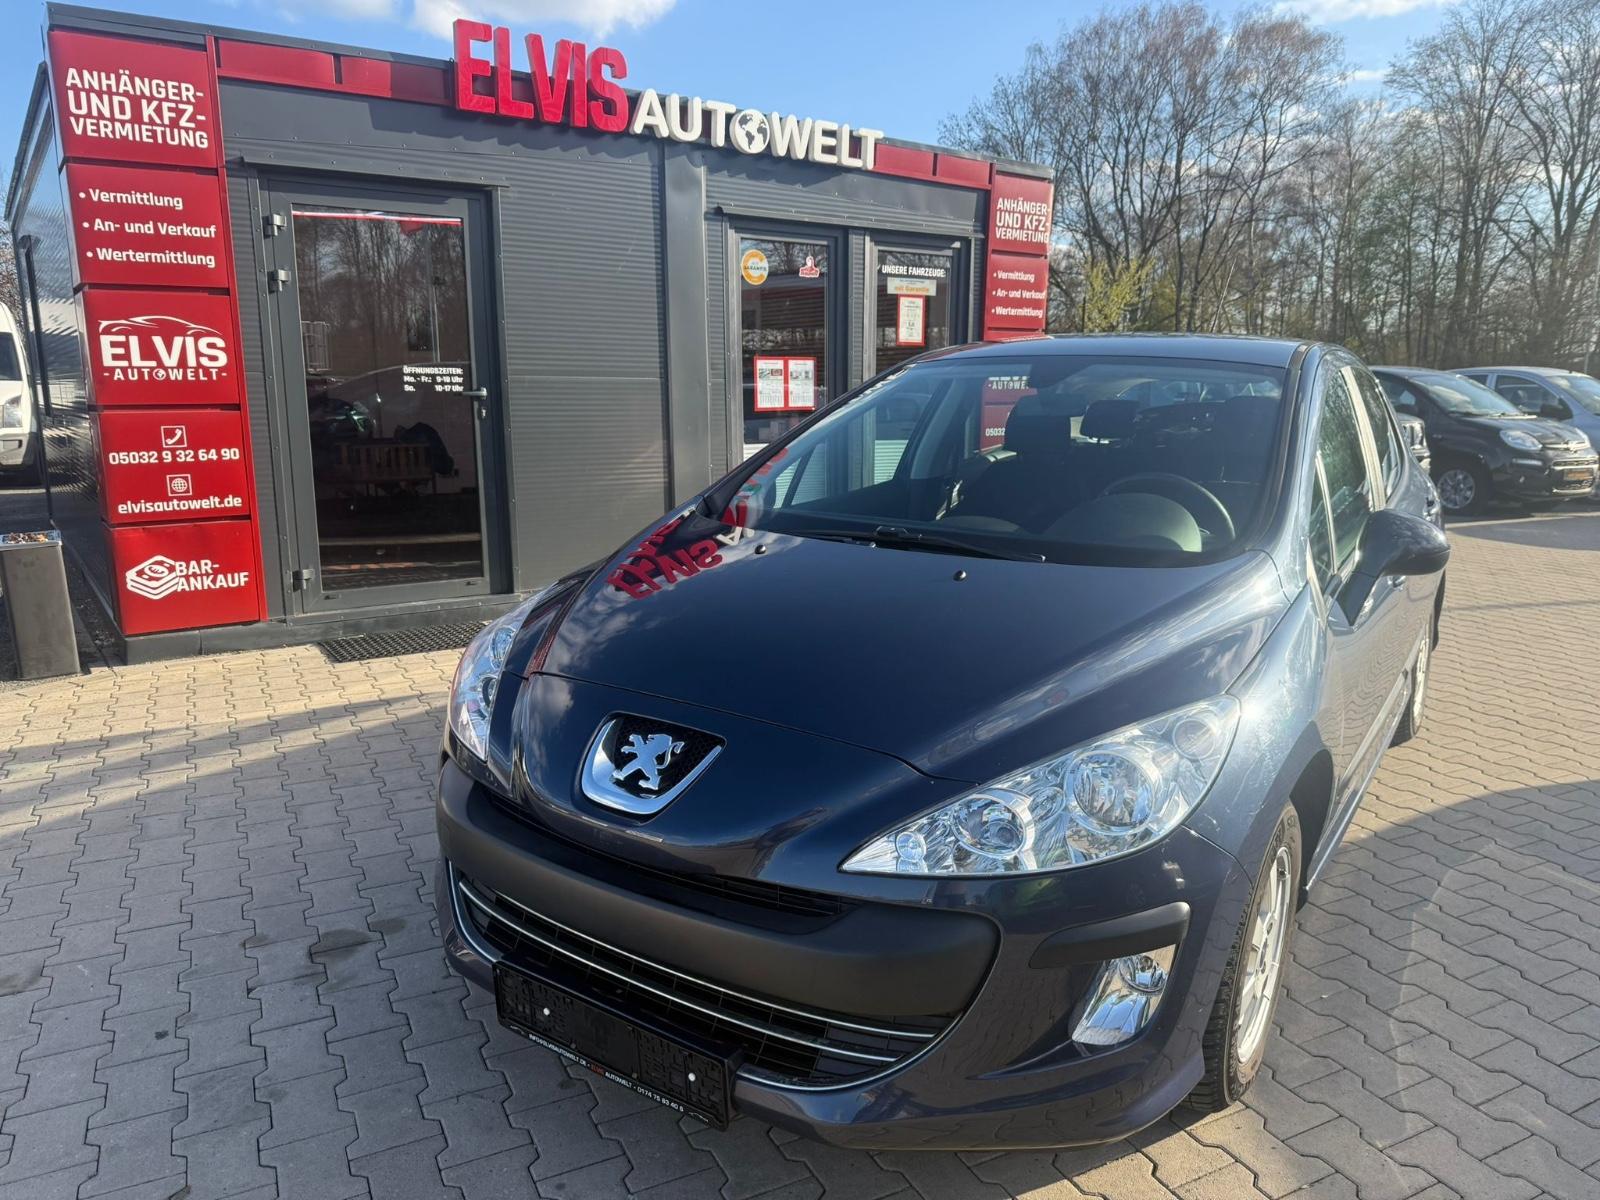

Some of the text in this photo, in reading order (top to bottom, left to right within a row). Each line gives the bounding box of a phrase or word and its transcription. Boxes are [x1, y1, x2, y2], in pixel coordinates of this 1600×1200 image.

[65, 67, 204, 103] ANHÄNGER-
[453, 18, 884, 171] ELVIS AUTOWELT
[67, 89, 206, 128] UND KFZ-
[69, 116, 208, 149] VERMIETUNG
[89, 188, 183, 210] Vermittlung
[996, 197, 1051, 216] ANHÄNGER-
[94, 218, 216, 238] An- und Verkauf
[996, 212, 1050, 231] UND KFZ-
[995, 227, 1049, 243] VERMIETUNG
[96, 247, 216, 268] Wertermittlung
[882, 264, 907, 275] UNSERE
[997, 270, 1035, 282] Vermittlung
[996, 288, 1046, 300] An- und Verkauf
[995, 306, 1043, 318] Wertermittlung
[100, 335, 228, 368] ELVIS
[403, 365, 463, 374] ÖFFNUNGSZEITEN:
[985, 427, 1005, 436] 05032
[109, 447, 239, 465] 05032 9 32 64 90
[117, 495, 242, 514] elvisautowelt.de
[175, 559, 219, 575] BAR-
[177, 571, 249, 592] ANKAUF
[637, 1086, 652, 1098] 0174
